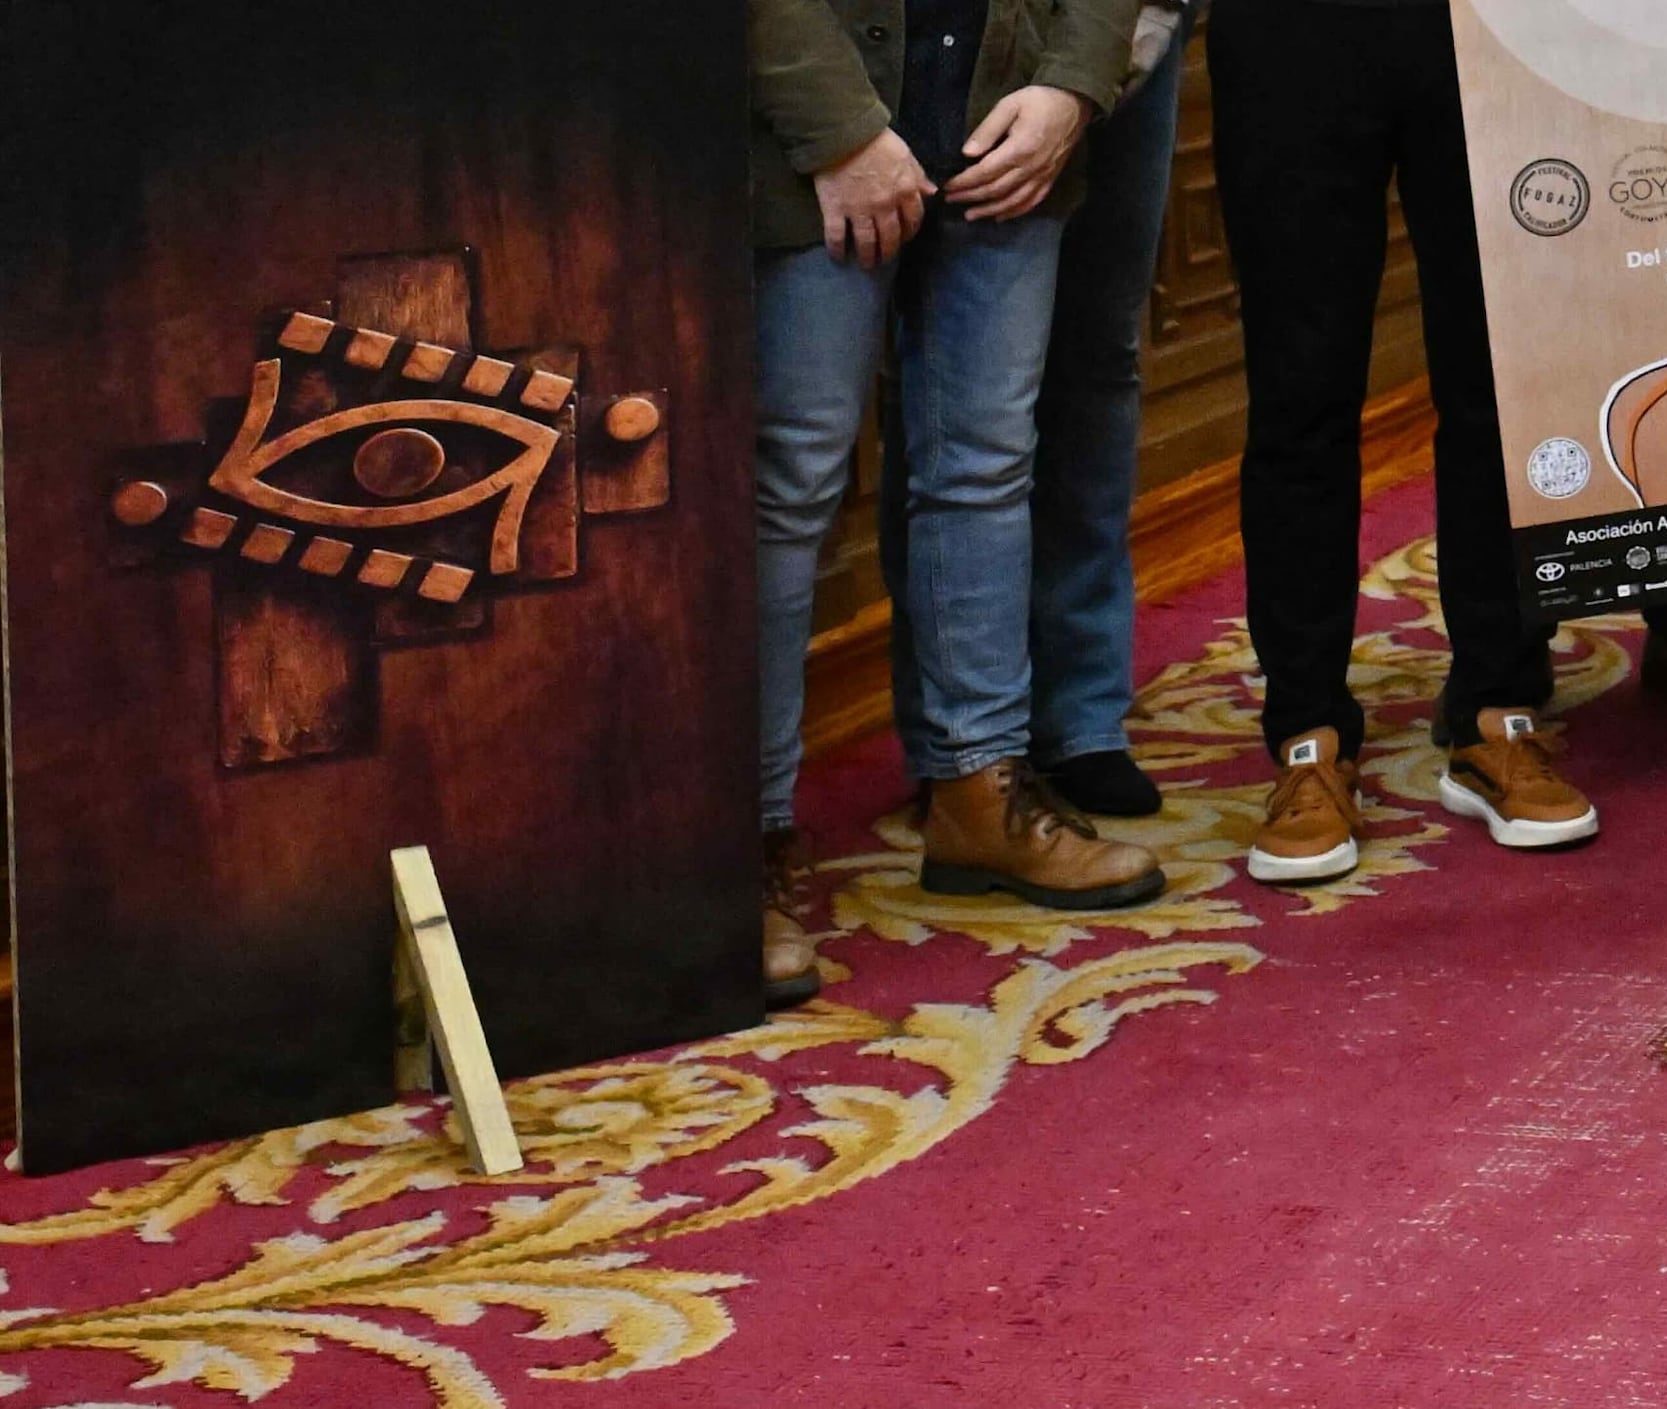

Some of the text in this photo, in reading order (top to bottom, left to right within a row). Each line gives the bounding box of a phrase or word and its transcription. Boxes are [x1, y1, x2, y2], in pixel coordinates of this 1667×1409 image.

[1523, 187, 1576, 207] FUGAZ
[1627, 248, 1660, 268] Del
[1565, 519, 1653, 545] Asociación
